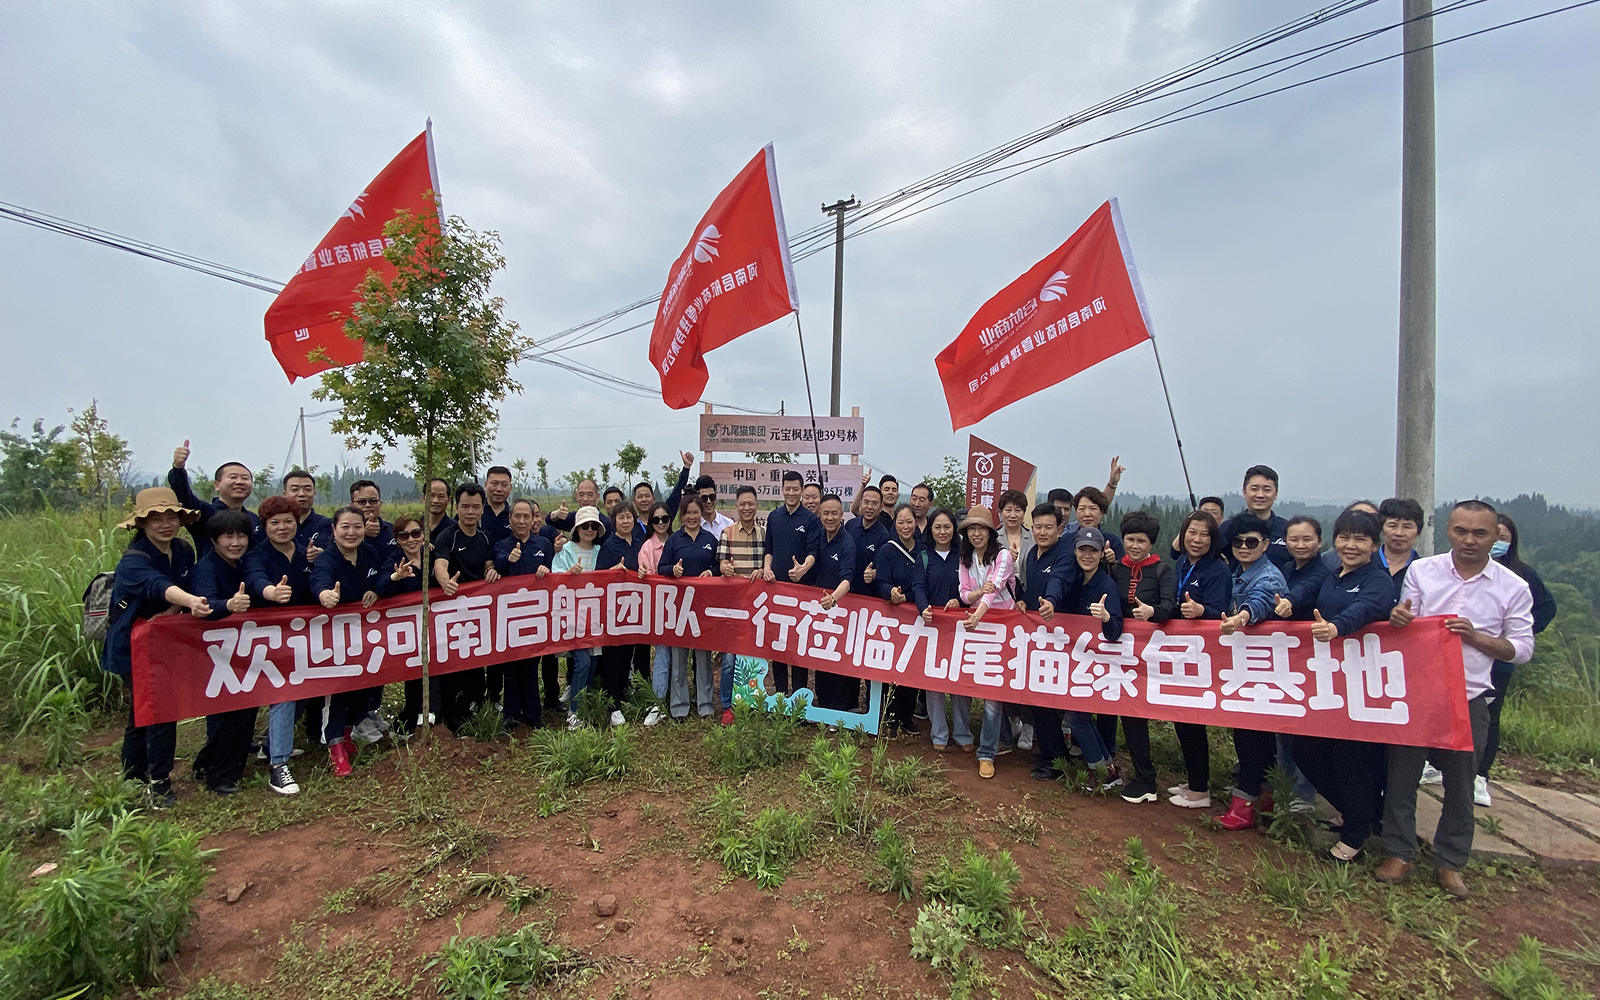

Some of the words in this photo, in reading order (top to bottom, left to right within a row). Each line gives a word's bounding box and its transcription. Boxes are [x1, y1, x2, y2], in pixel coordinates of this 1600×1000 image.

[721, 424, 766, 437] 九尾猫集团
[769, 427, 858, 442] 元宝枫基地39号林
[1000, 456, 1011, 495] 远觉镇高
[980, 477, 995, 510] 健康
[202, 582, 1410, 726] 欢迎河南启航团队一行莅临九尾猫绿色基地
